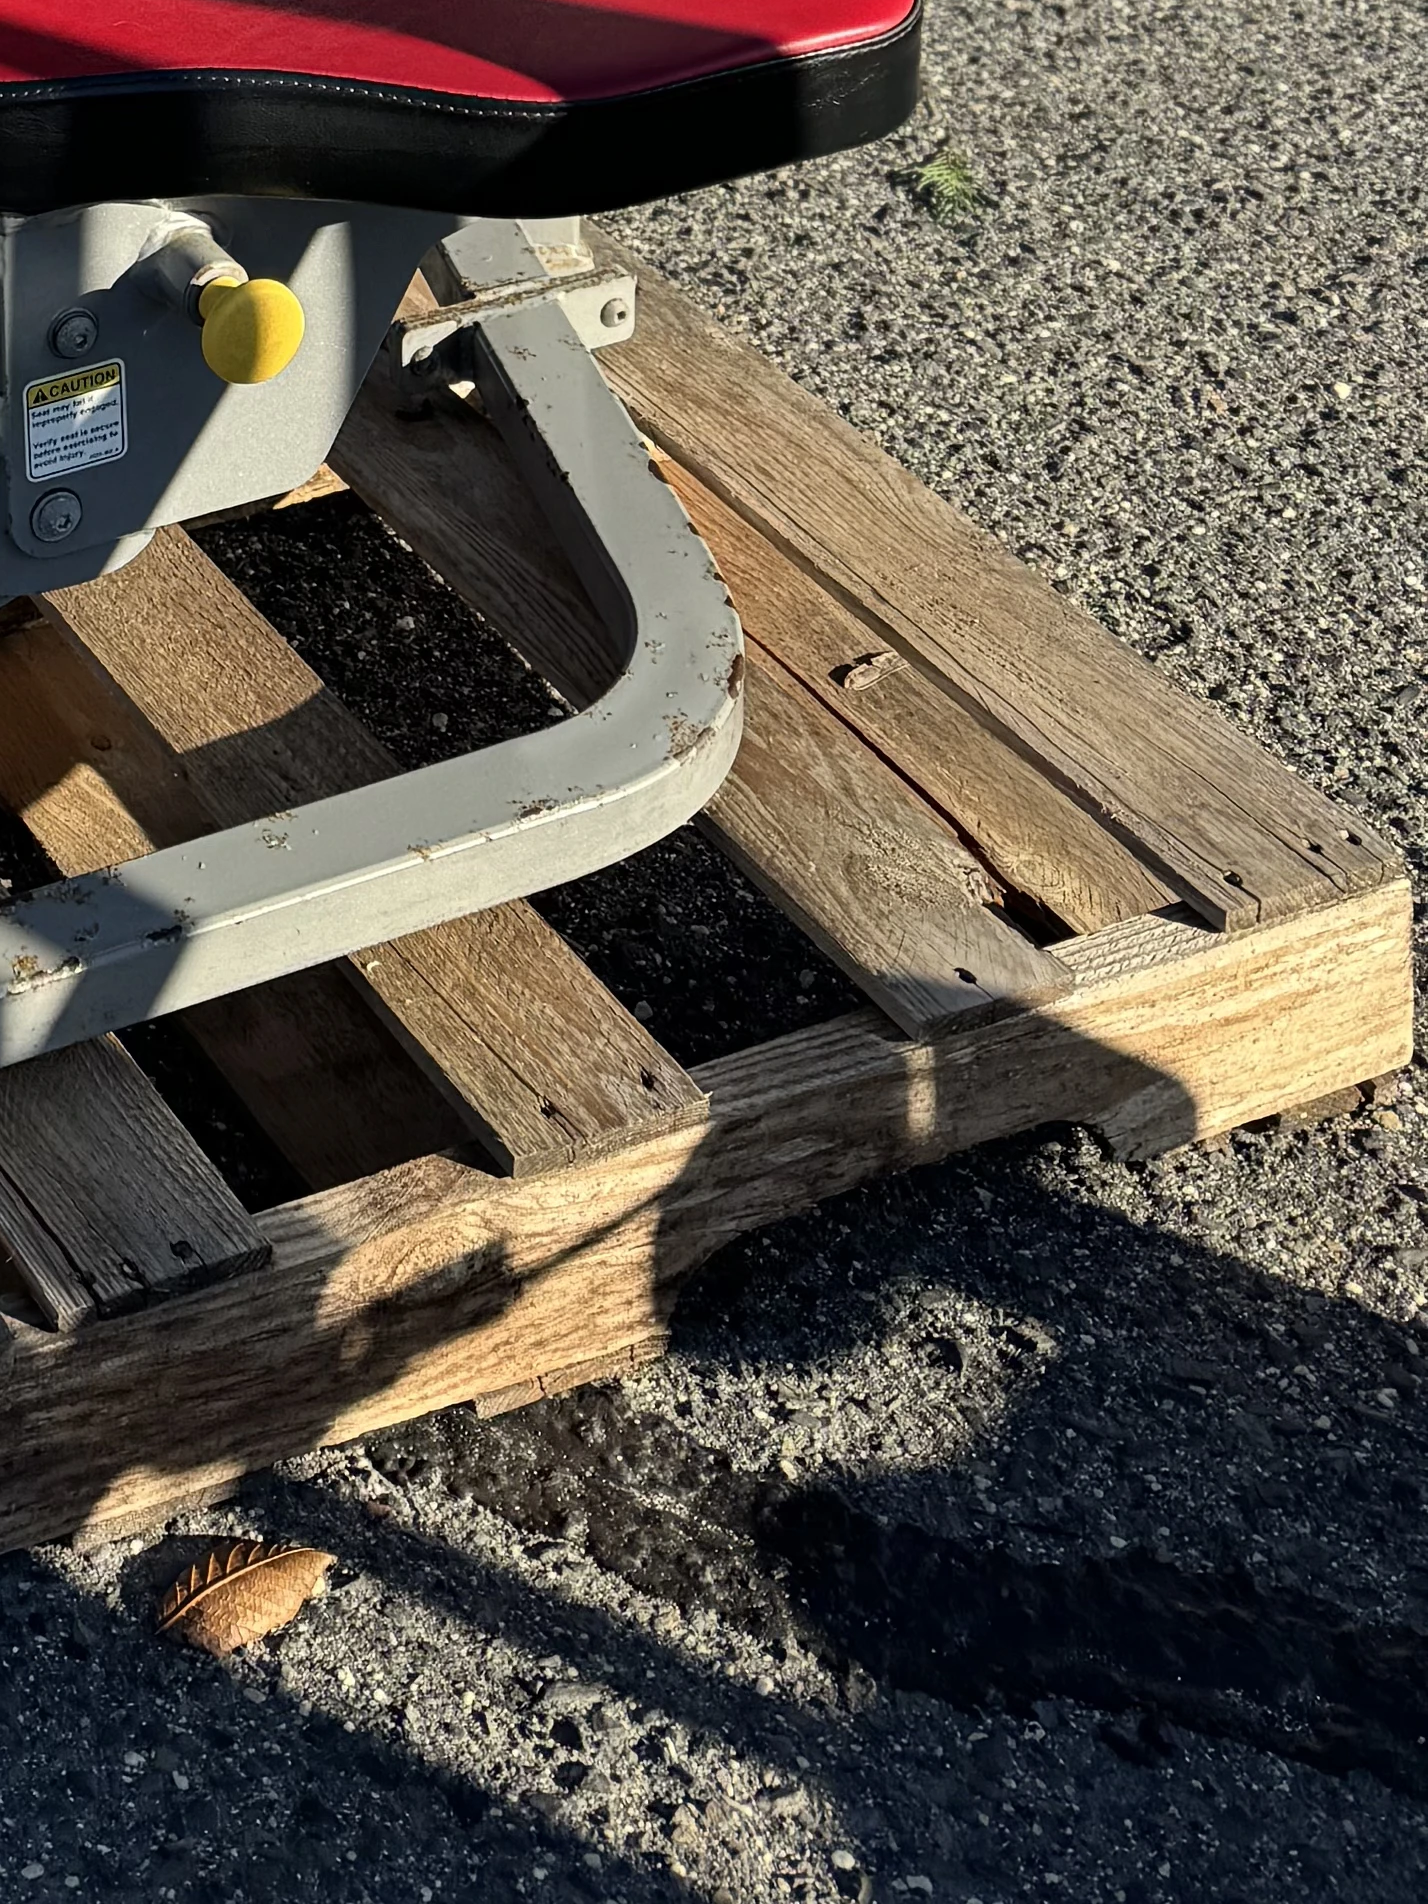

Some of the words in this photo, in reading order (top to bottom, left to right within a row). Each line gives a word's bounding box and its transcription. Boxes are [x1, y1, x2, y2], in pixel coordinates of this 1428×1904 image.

[49, 369, 115, 397] CAUTION
[53, 403, 70, 412] may
[32, 438, 57, 449] Verify
